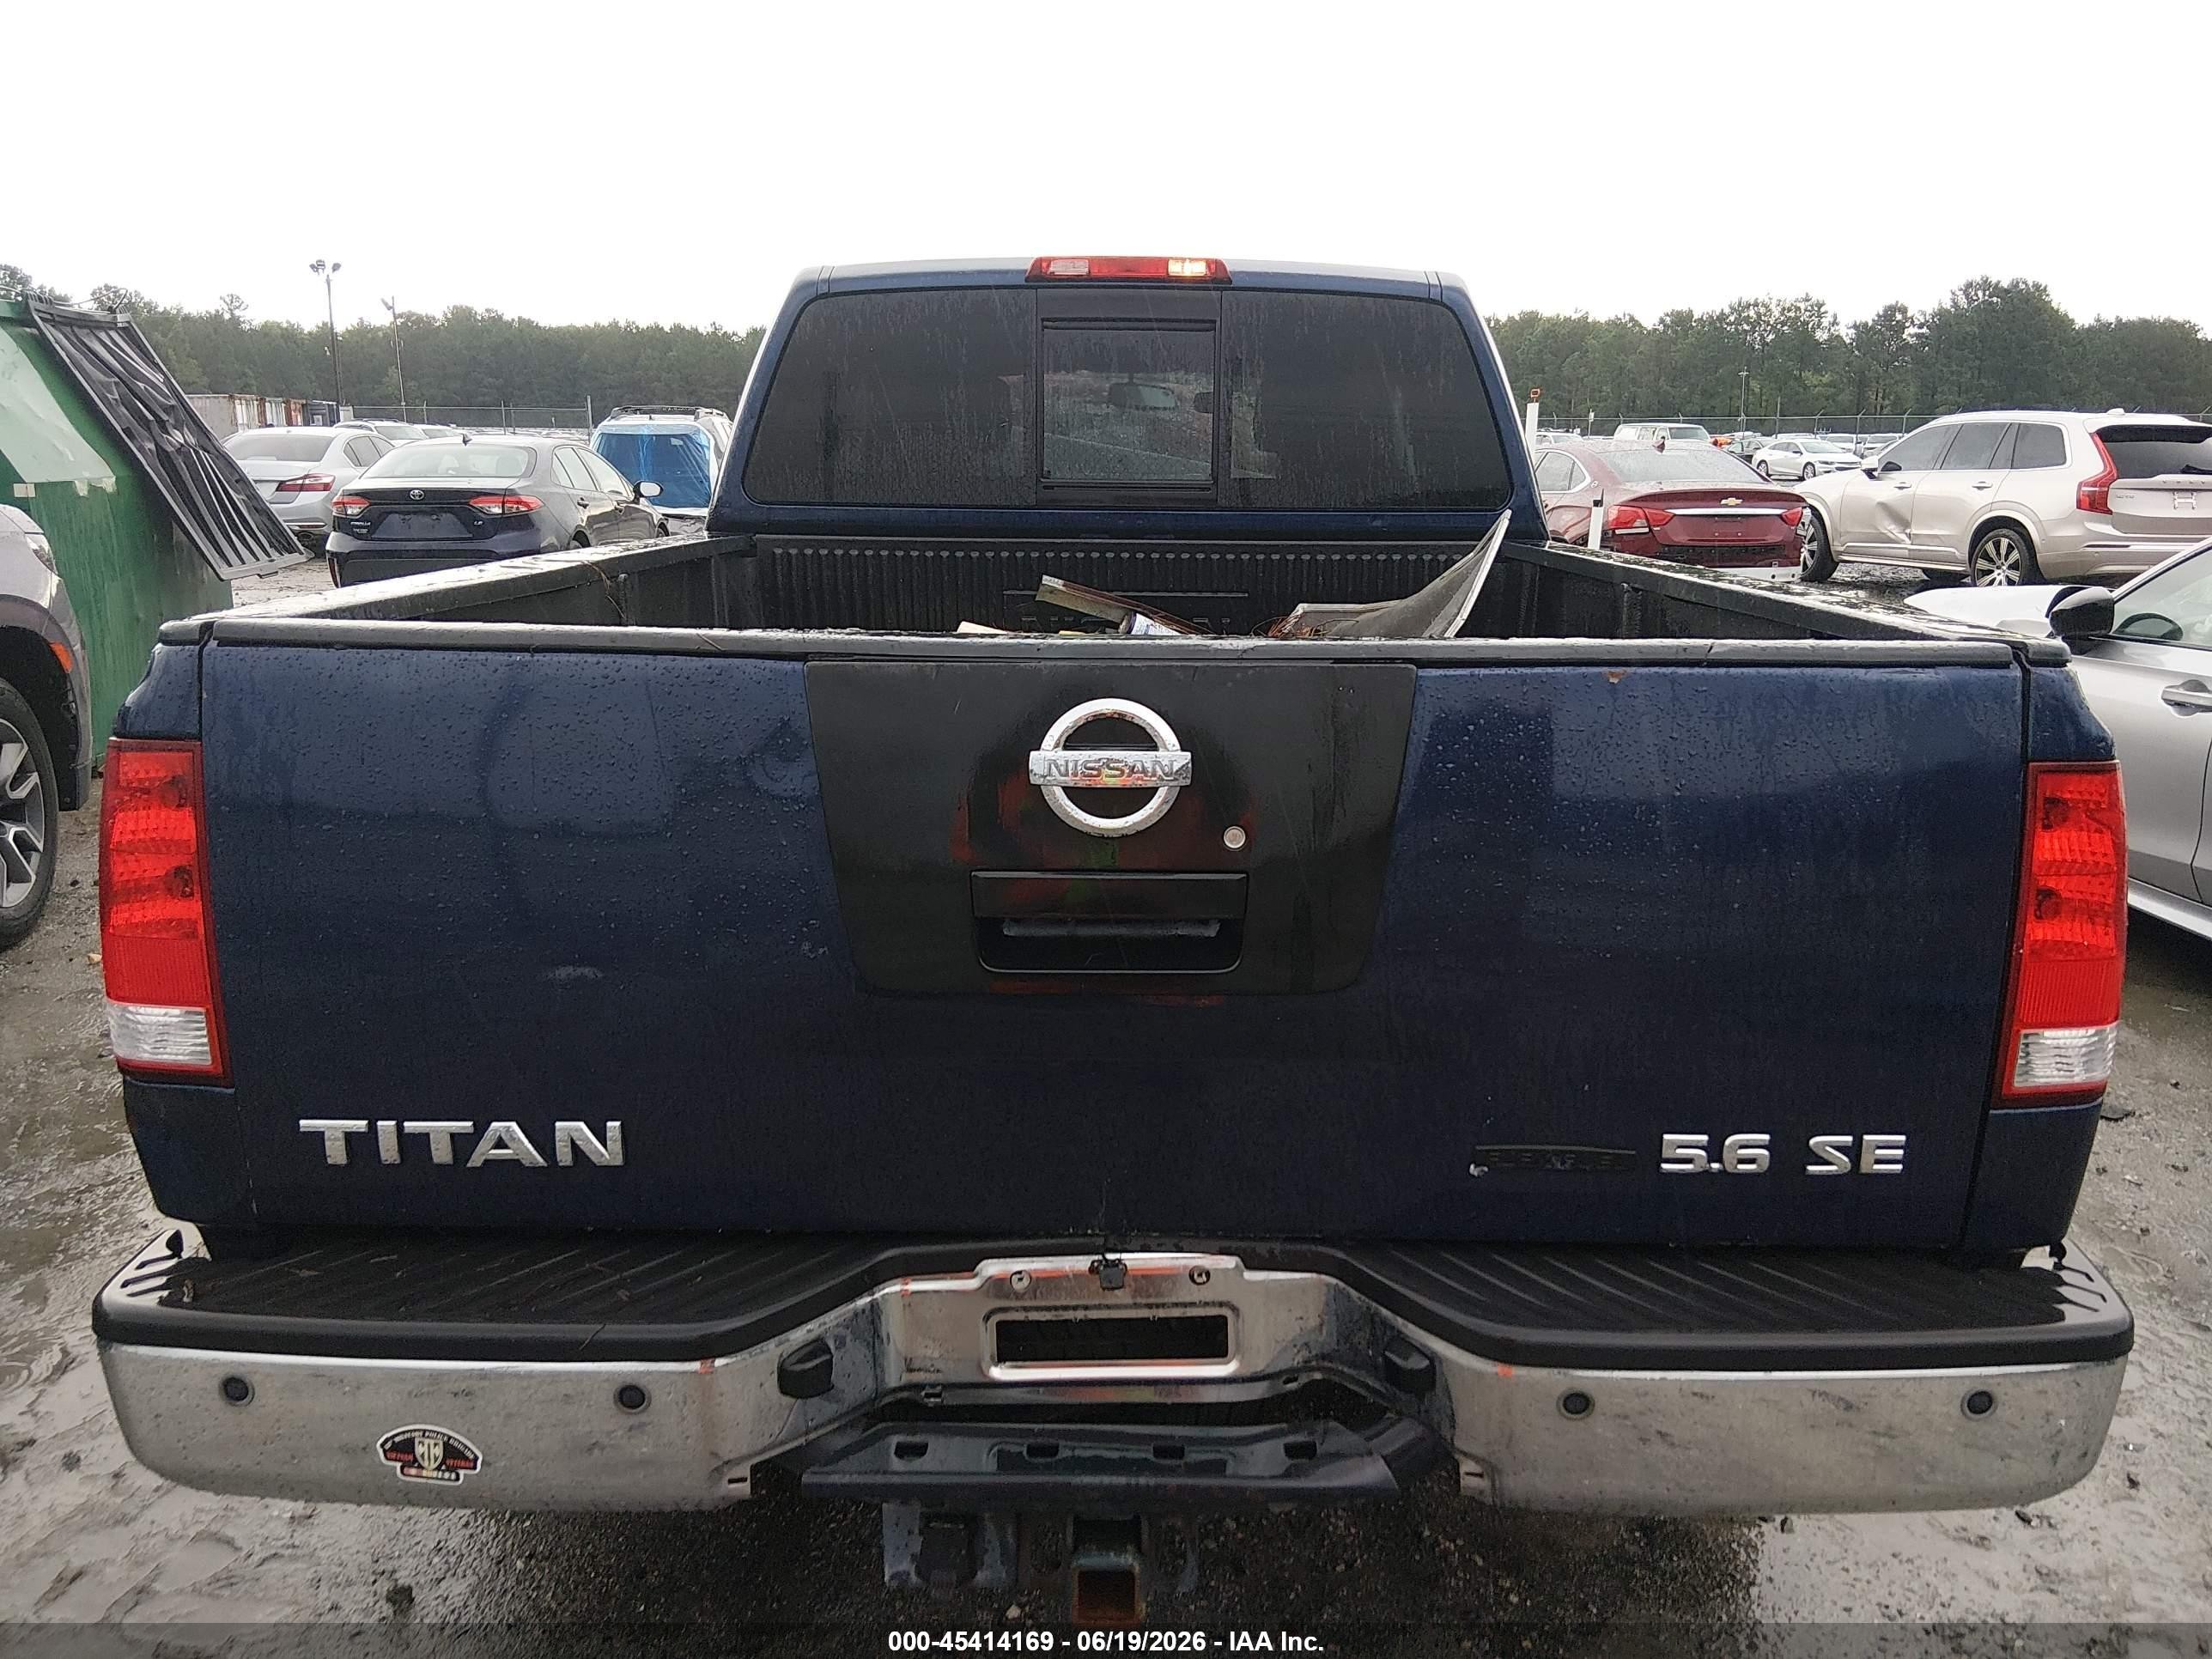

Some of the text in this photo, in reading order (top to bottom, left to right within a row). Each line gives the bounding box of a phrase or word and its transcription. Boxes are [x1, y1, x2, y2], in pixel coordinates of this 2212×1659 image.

[1046, 758, 1175, 781] NISSAN
[298, 1119, 625, 1167] TITAN
[1660, 1133, 1907, 1175] 5.6 SE
